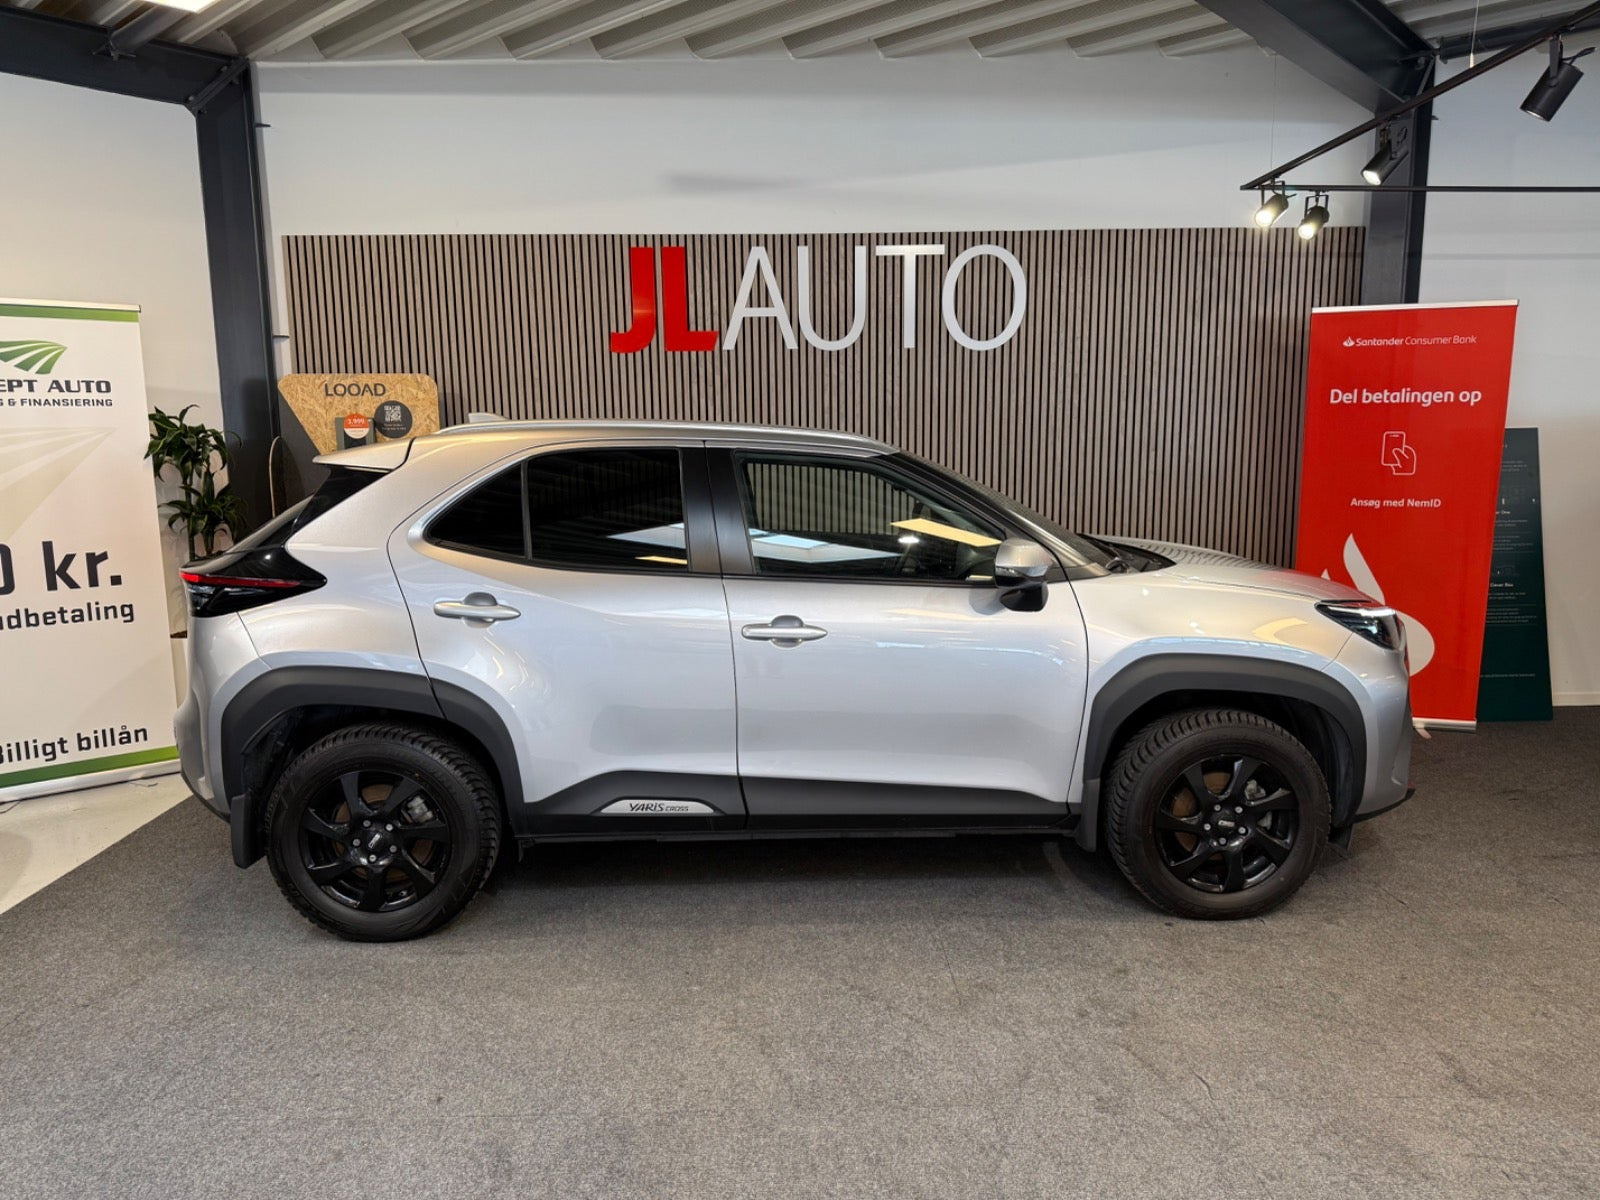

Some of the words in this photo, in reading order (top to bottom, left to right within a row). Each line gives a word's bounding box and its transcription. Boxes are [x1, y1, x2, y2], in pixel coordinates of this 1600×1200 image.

[1356, 336, 1403, 347] Santander
[1405, 335, 1451, 346] Consumer
[1453, 334, 1477, 344] Bank
[48, 380, 112, 393] AUTO
[325, 383, 386, 397] LOOAD
[8, 398, 16, 407] &
[20, 398, 113, 407] FINANSIERING
[1330, 388, 1358, 404] Del
[1362, 388, 1454, 407] betalingen
[1459, 390, 1482, 406] op
[1350, 497, 1380, 509] Ansøg
[1383, 498, 1405, 507] med
[1407, 498, 1442, 508] NemID
[42, 540, 122, 592] kr.
[0, 602, 134, 630] dbetaling
[77, 725, 148, 751] billån
